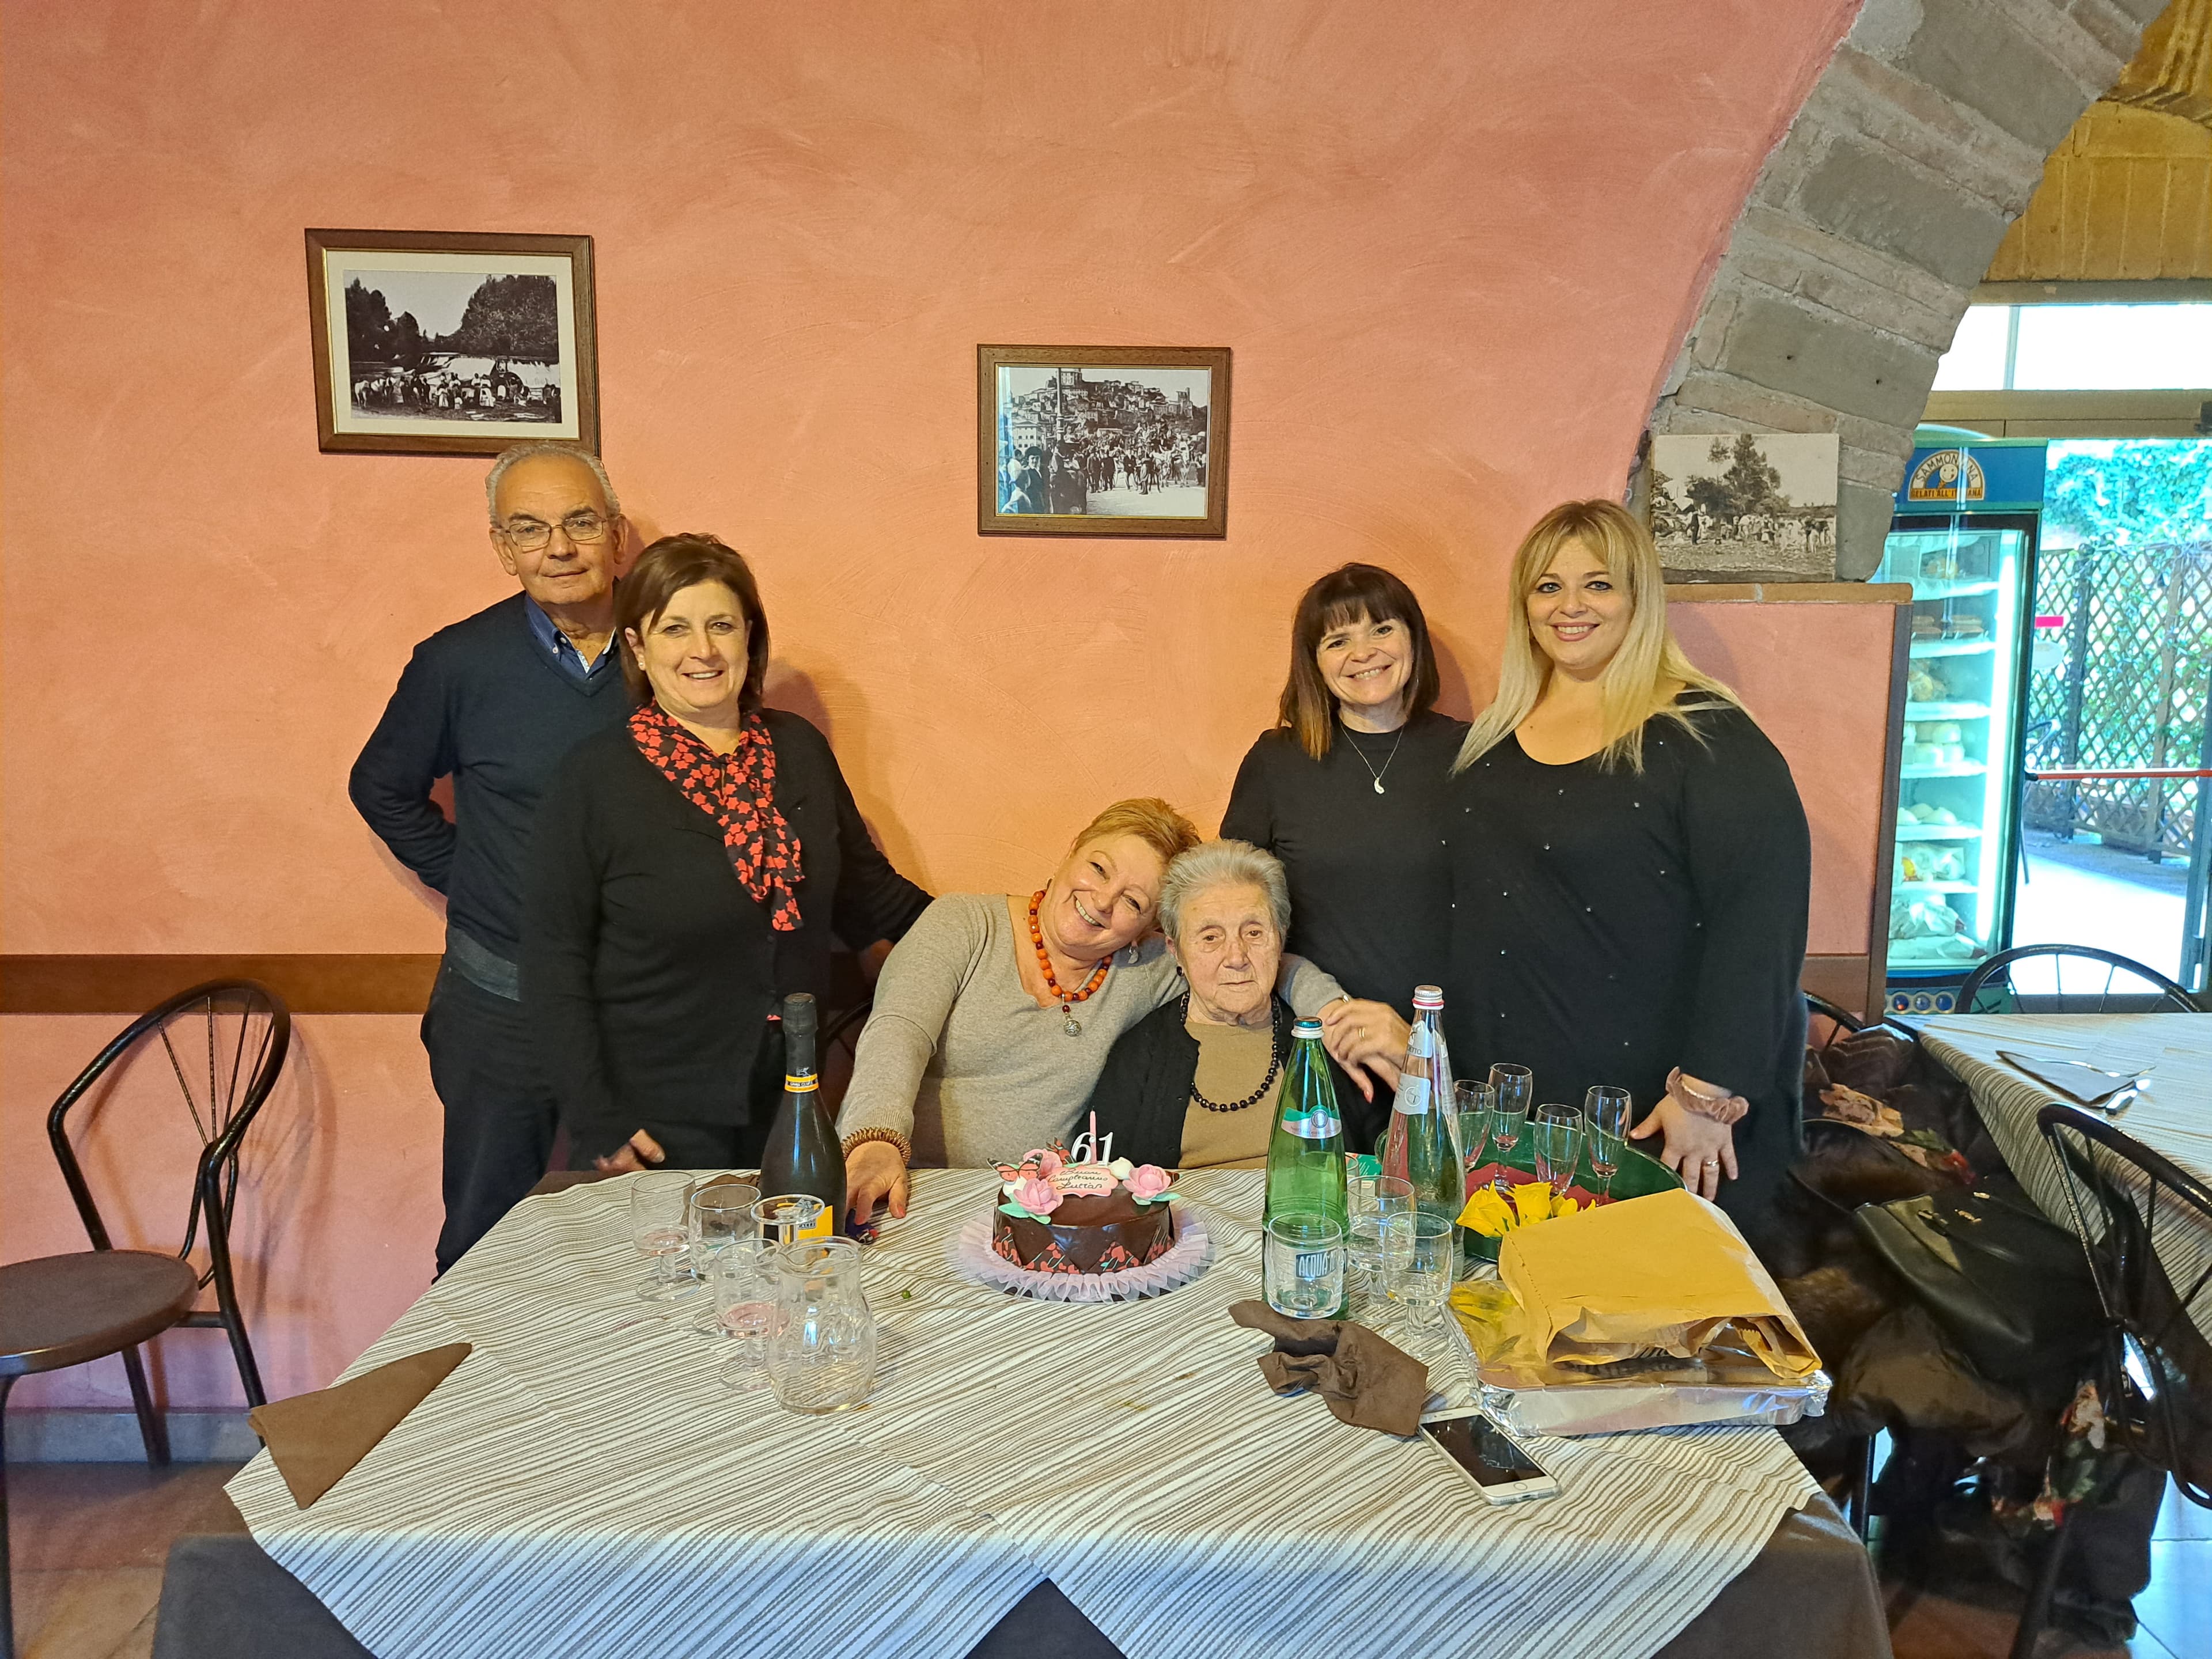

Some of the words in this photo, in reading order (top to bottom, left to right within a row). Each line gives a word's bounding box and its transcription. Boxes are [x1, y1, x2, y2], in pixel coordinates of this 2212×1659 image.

[1916, 453, 1978, 481] SAMMONNA
[1071, 1132, 1113, 1166] 61
[1298, 1251, 1328, 1278] ACQUA
